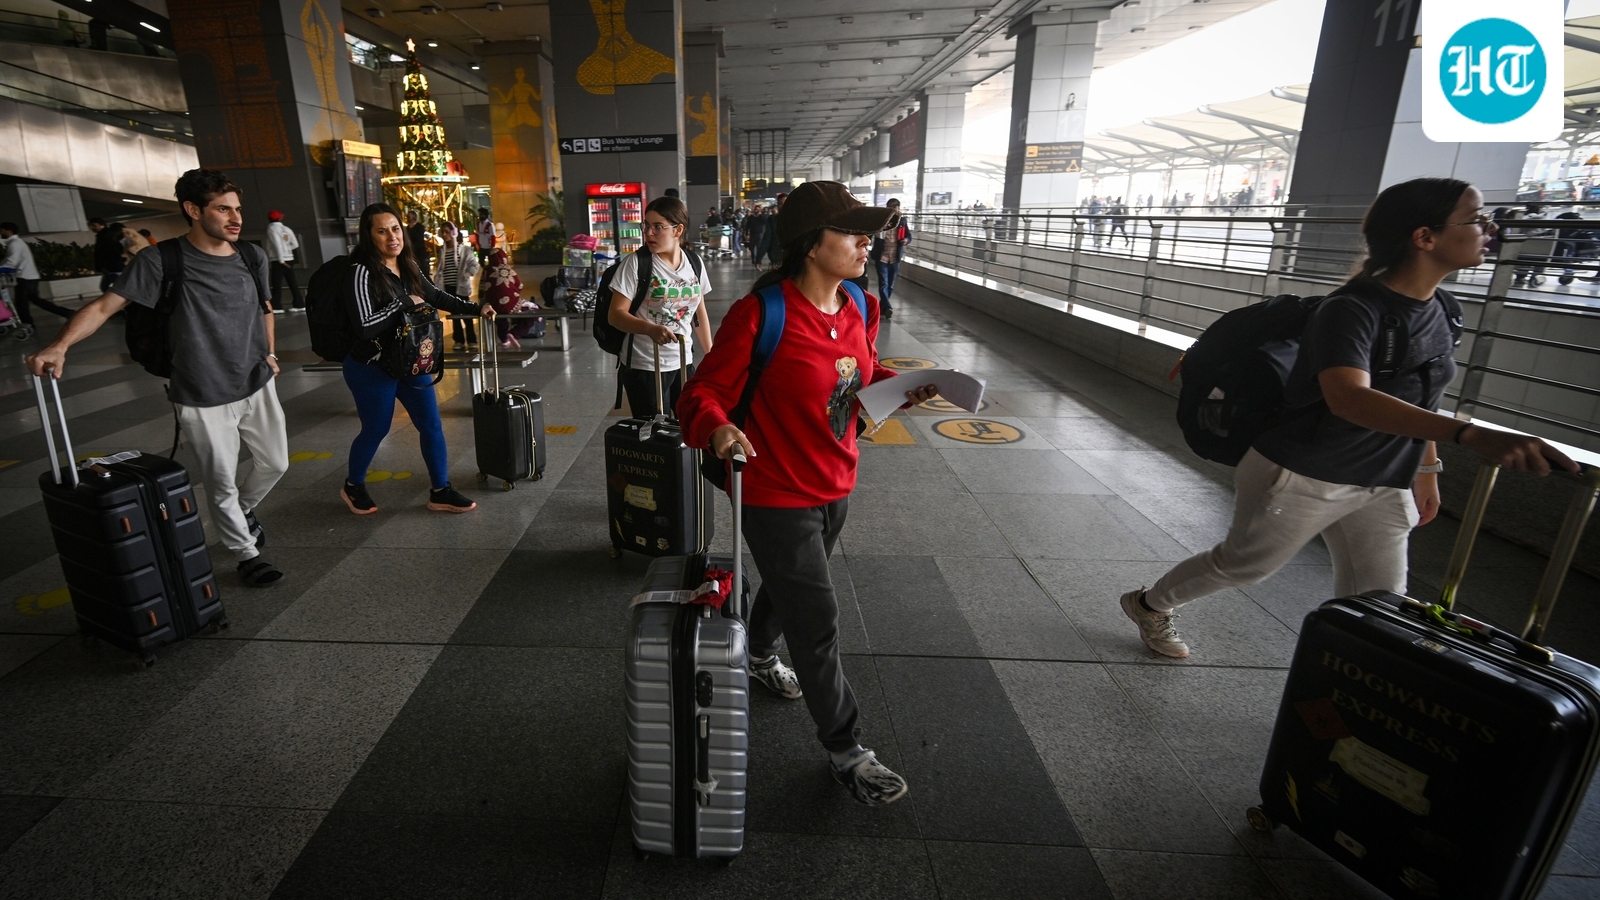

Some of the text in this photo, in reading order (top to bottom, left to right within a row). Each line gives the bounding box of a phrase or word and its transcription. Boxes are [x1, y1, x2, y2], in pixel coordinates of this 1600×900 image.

[1060, 114, 1083, 138] 12
[615, 137, 639, 145] Waiting
[611, 446, 665, 464] HOGWARTS
[618, 463, 659, 479] EXPRESS
[1322, 651, 1499, 745] HOGWARTS
[1331, 687, 1460, 763] EXPRESS
